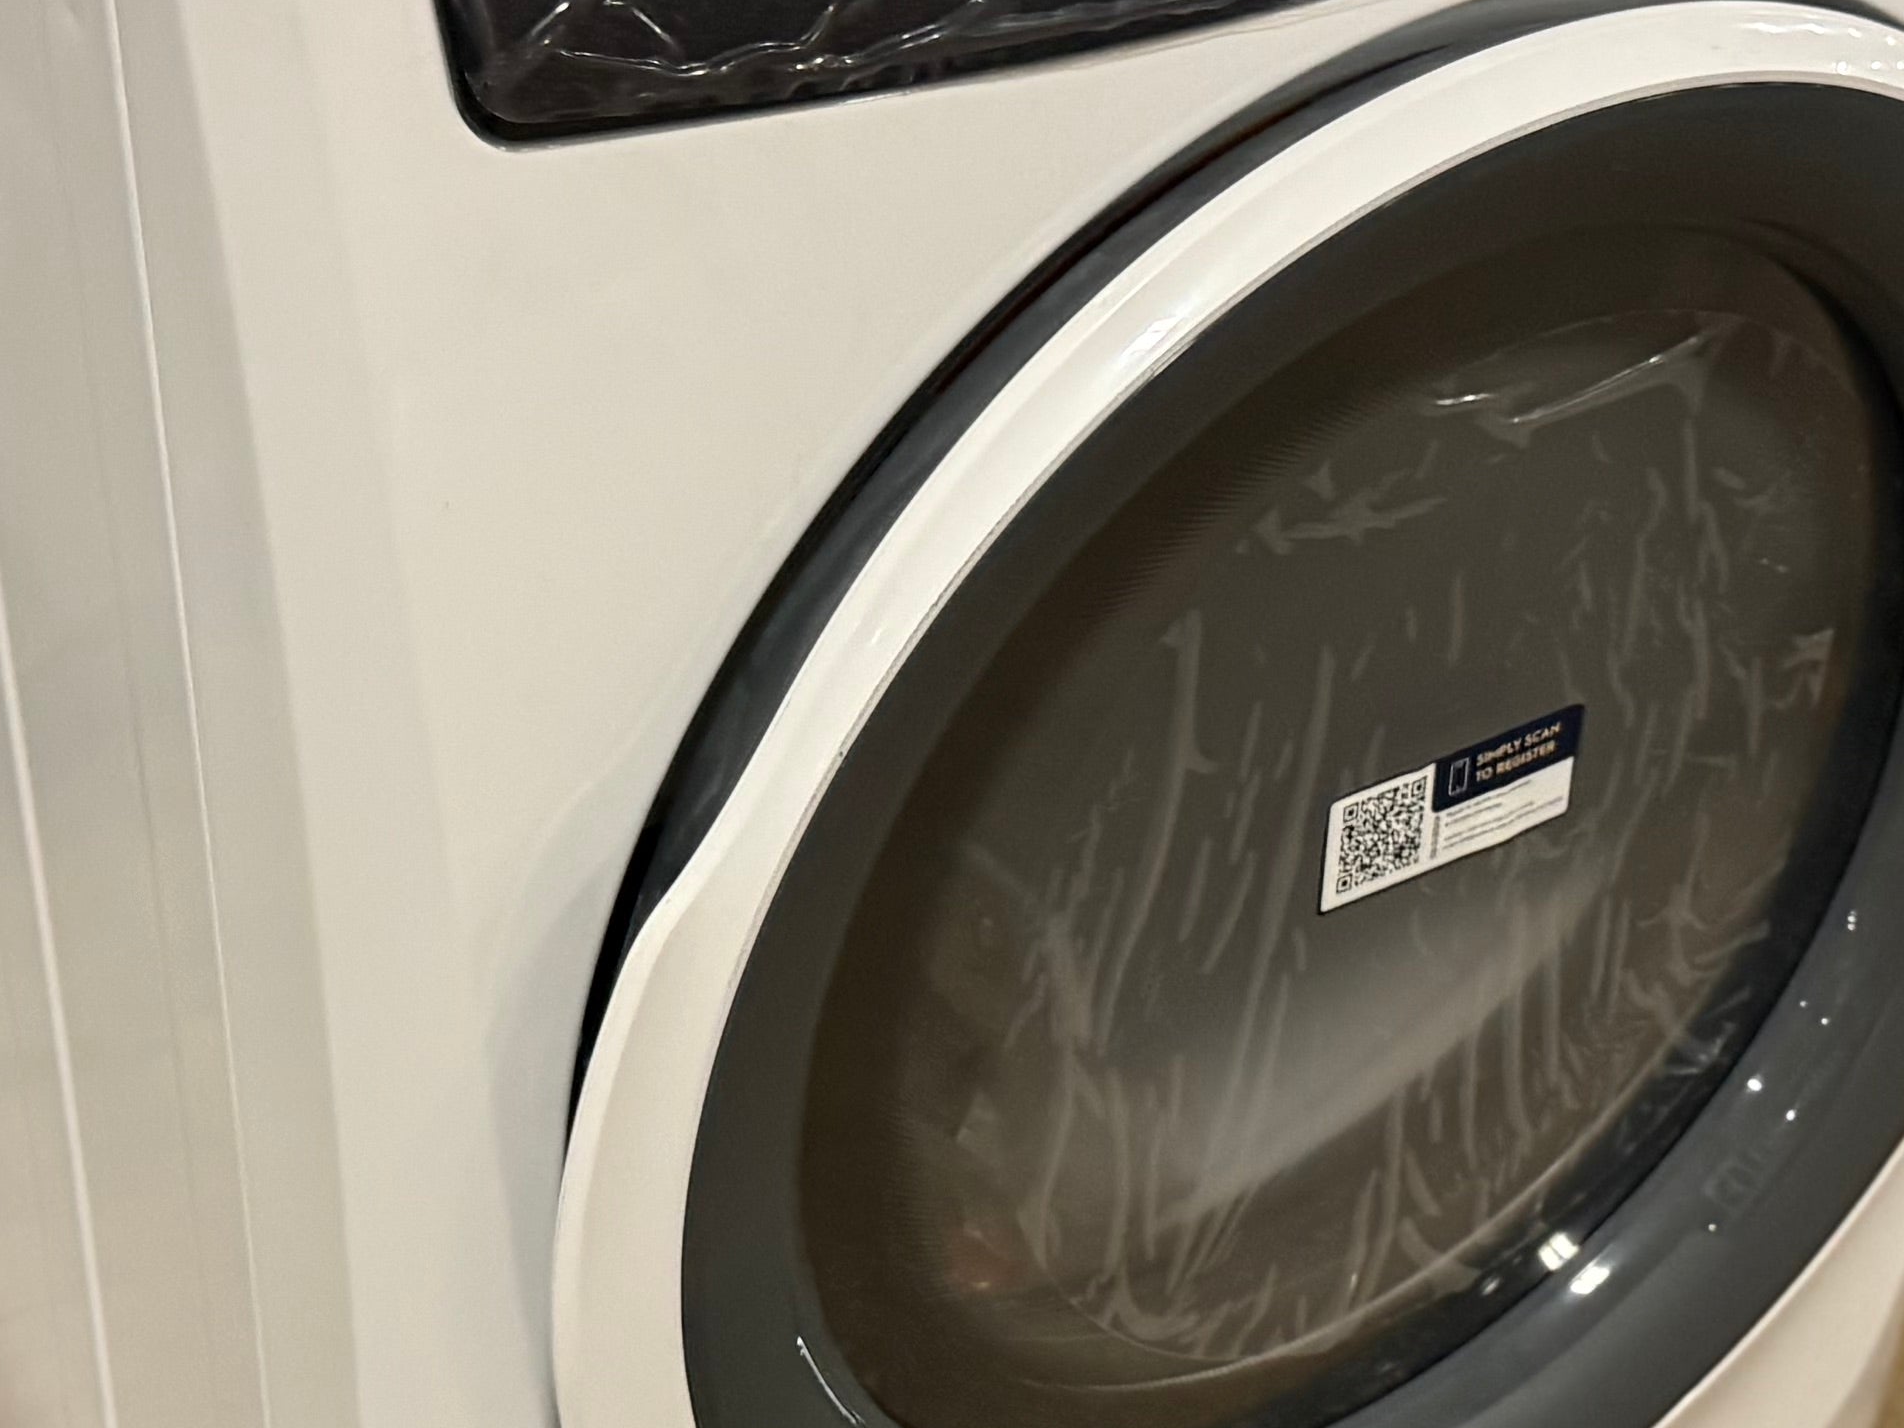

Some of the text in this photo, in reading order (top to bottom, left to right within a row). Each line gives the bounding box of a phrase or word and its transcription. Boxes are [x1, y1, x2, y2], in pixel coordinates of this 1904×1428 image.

[1476, 721, 1561, 767] SIMPLY SCAN
[1476, 739, 1557, 782] TO REGISTER
